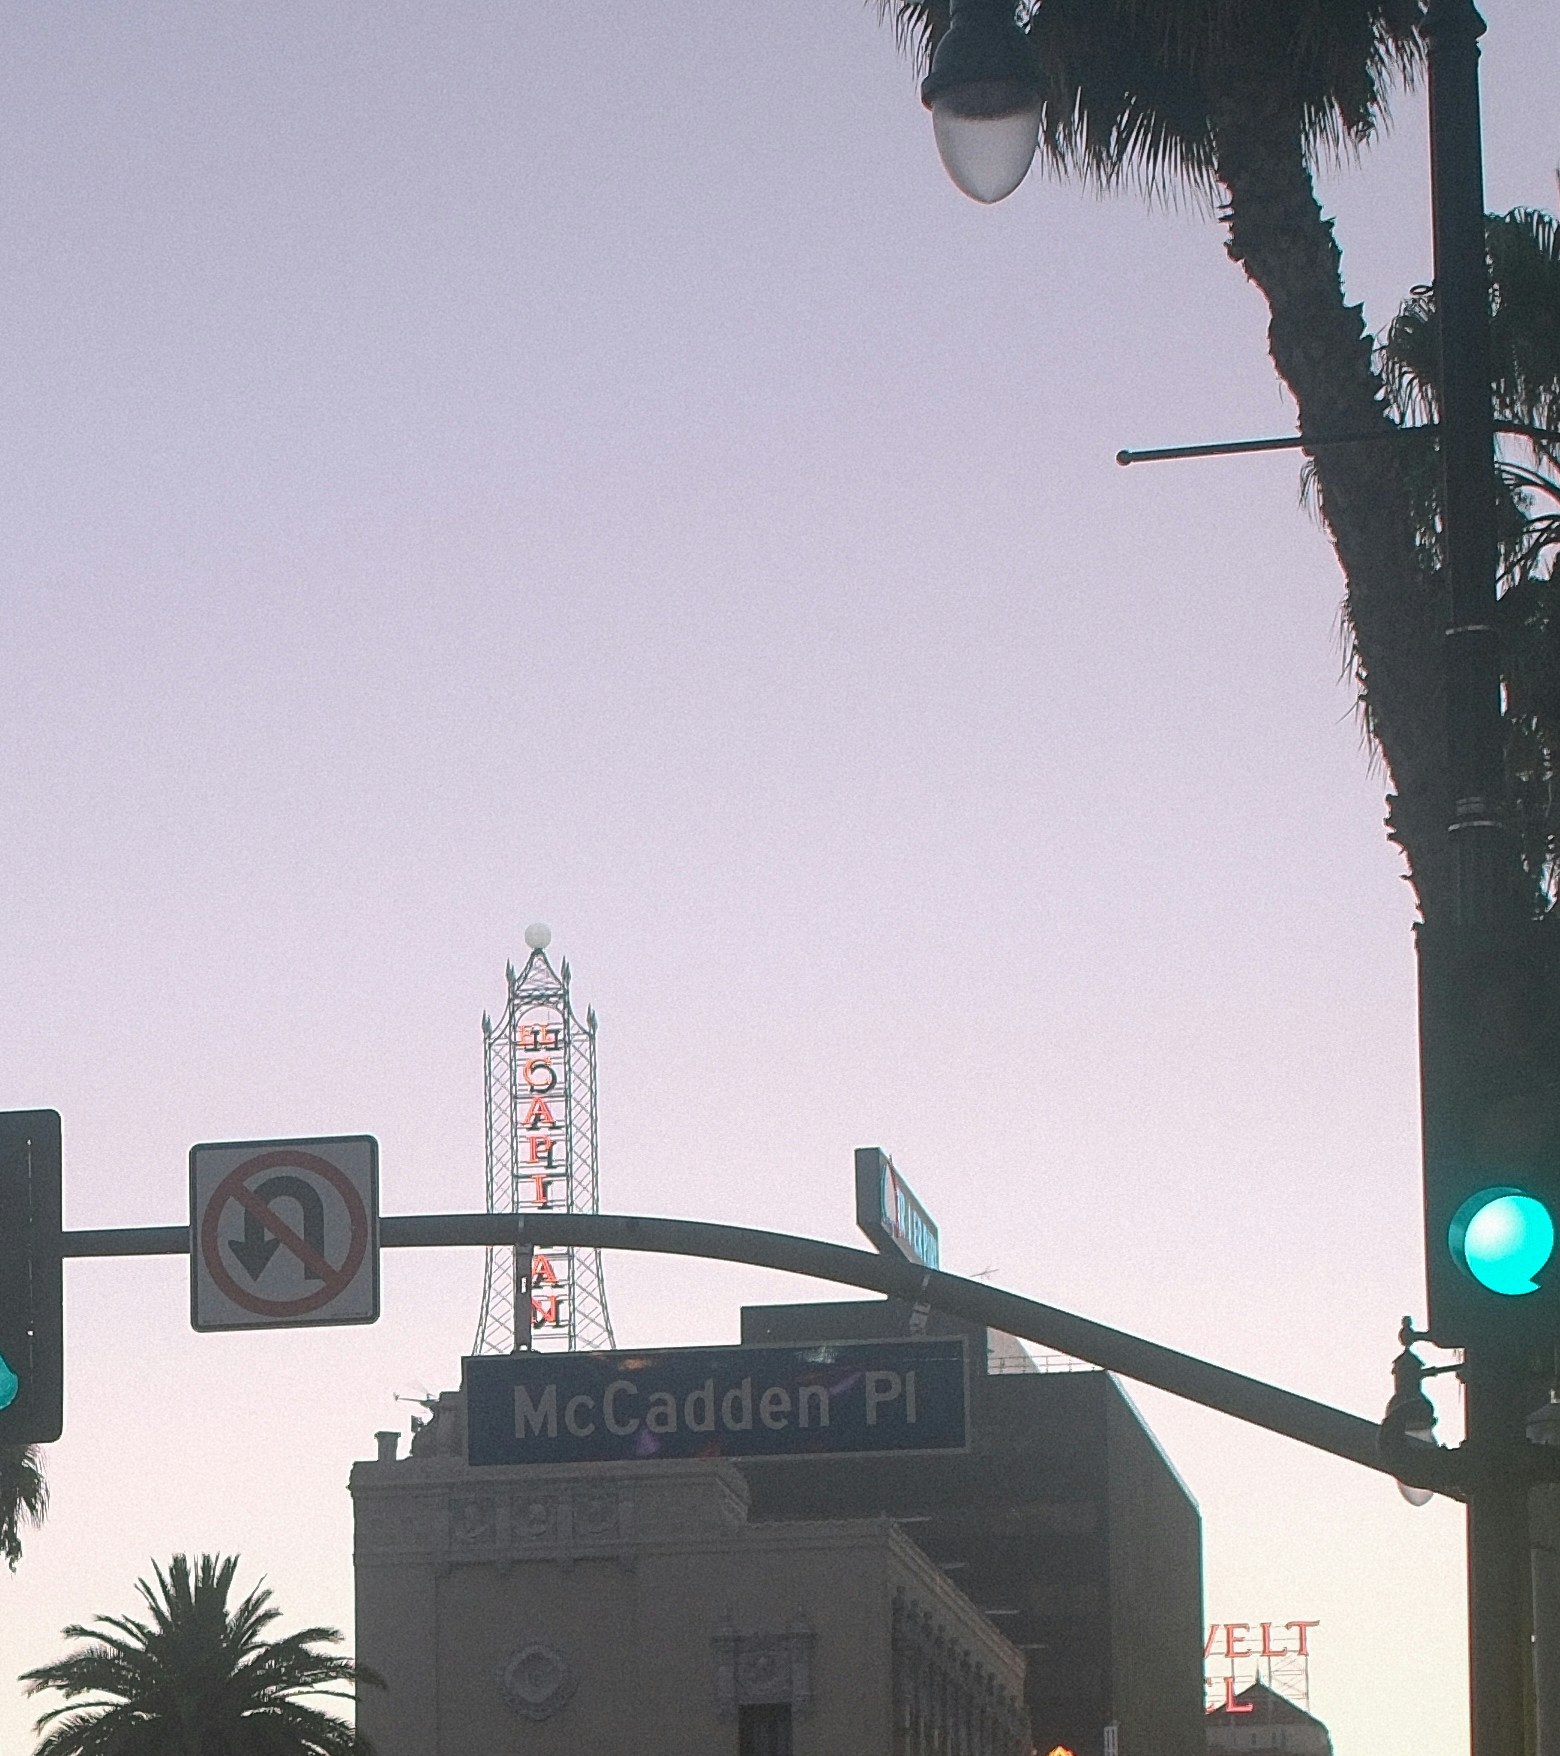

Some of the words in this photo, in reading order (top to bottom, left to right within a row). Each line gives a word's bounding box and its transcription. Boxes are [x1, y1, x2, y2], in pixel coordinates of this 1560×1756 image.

[523, 1058, 560, 1326] CAPIAN
[513, 1376, 830, 1439] McCadden
[866, 1369, 917, 1426] Pl
